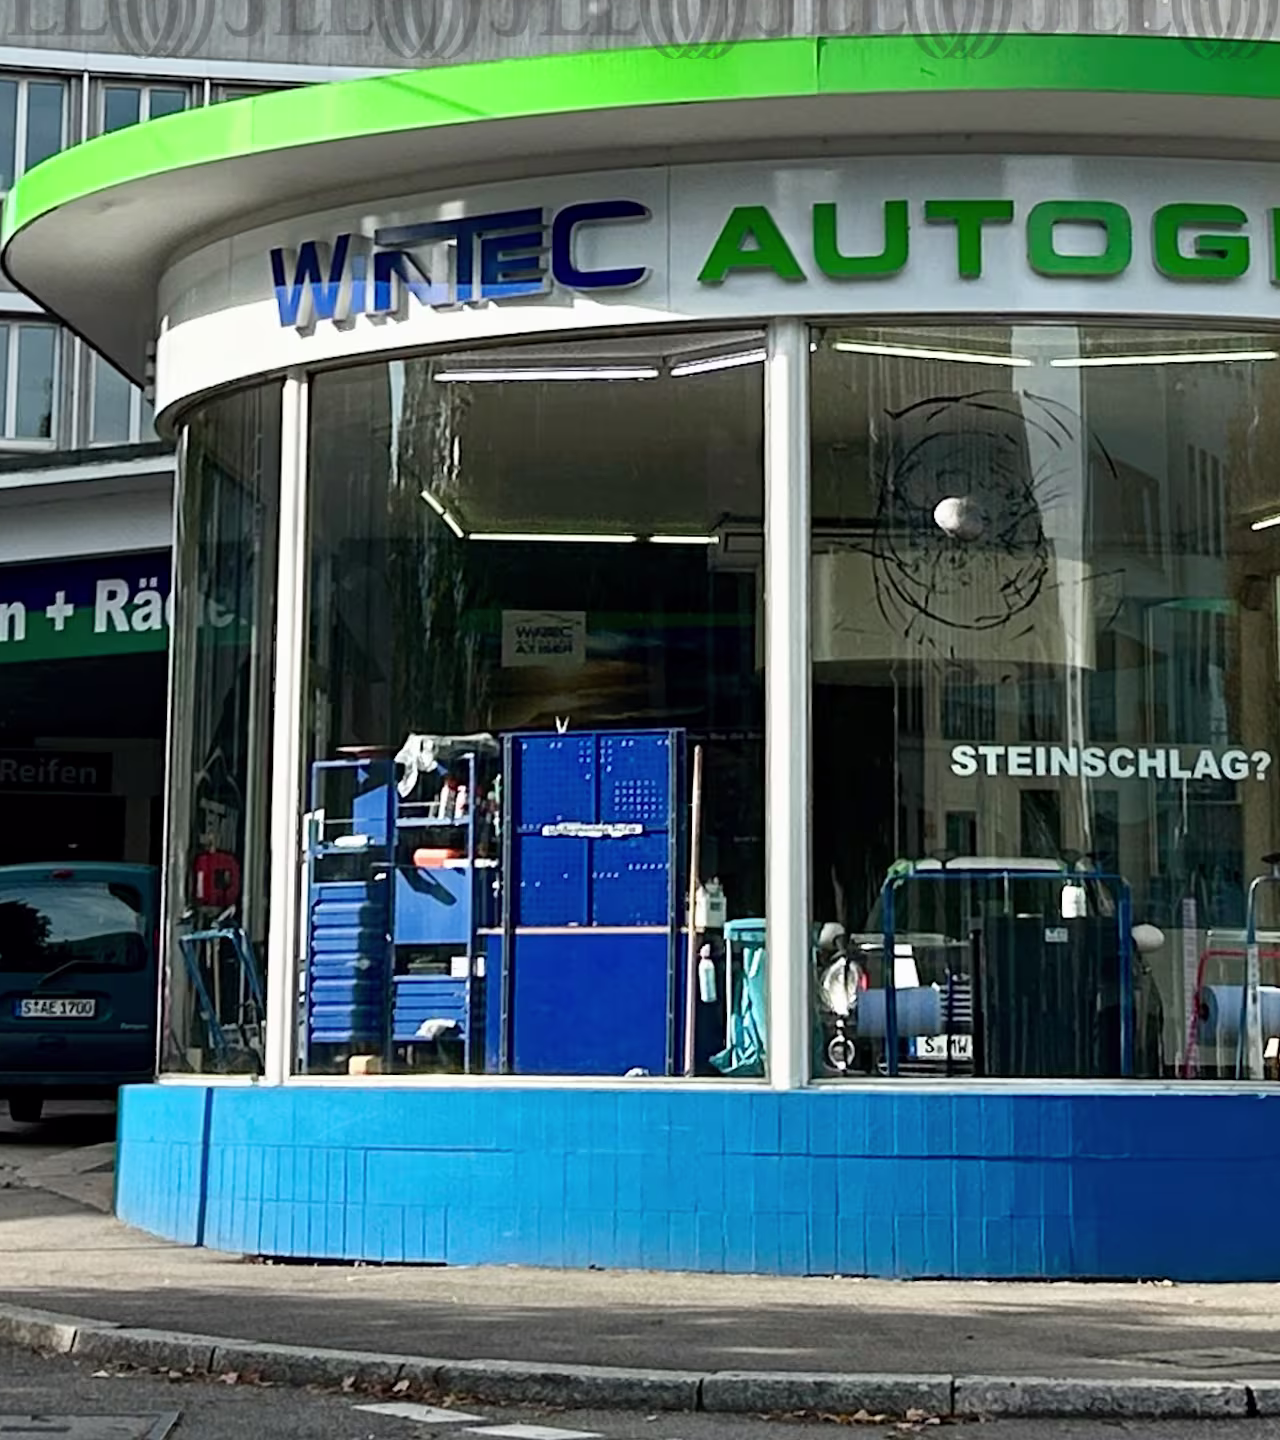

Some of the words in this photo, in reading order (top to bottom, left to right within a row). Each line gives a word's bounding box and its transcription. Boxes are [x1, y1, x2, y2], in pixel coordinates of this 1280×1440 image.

[270, 200, 650, 330] WINTEC
[45, 591, 74, 632] +
[0, 758, 97, 784] Reifen
[950, 744, 1272, 781] STEINSCHLAG?
